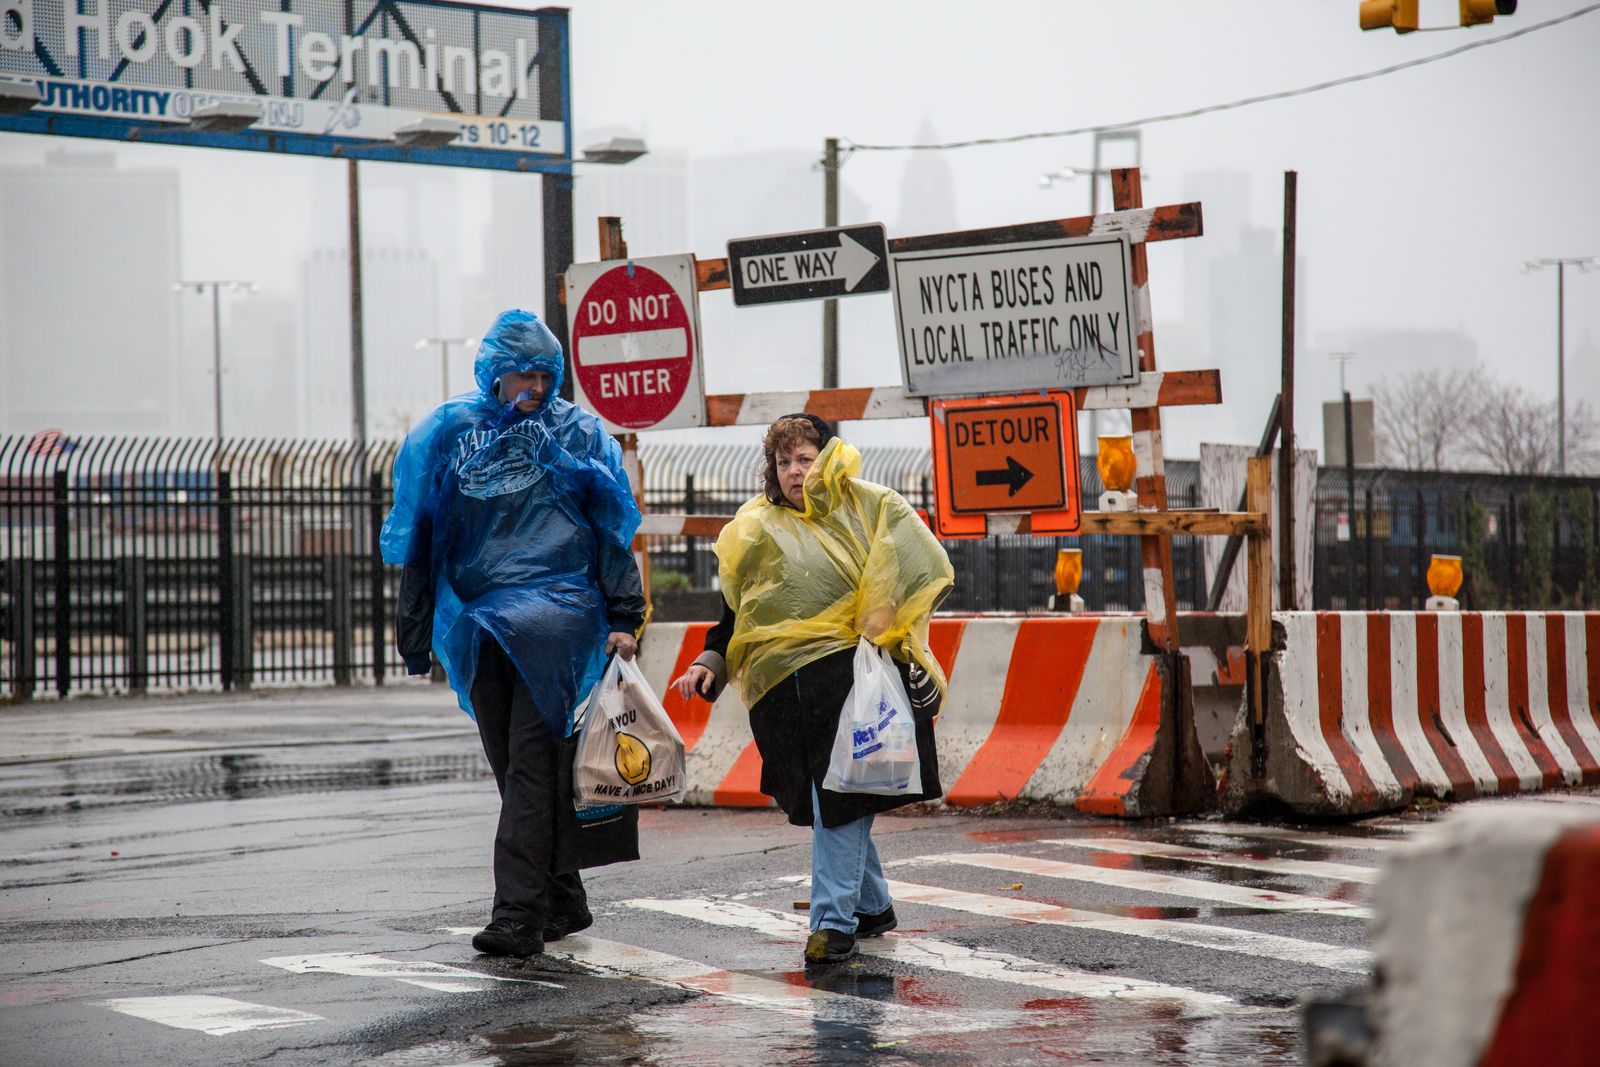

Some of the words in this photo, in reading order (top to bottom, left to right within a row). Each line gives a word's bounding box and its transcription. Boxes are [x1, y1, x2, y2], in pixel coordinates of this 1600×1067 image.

[66, 0, 246, 73] Hook
[261, 11, 529, 99] Terminal
[487, 121, 540, 147] 10-12
[746, 257, 789, 285] ONE
[795, 251, 838, 279] WAY
[919, 272, 984, 315] NYCTA
[991, 265, 1055, 309] BUSES
[1065, 261, 1103, 303] AND
[588, 299, 617, 326] DO
[629, 294, 670, 322] NOT
[911, 324, 974, 365] LOCAL
[980, 316, 1061, 361] TRAFFIC
[1070, 312, 1120, 357] ONLY
[599, 368, 671, 398] ENTER
[955, 416, 1050, 447] DETOUR
[615, 708, 637, 728] YOU
[594, 784, 623, 797] HAVE
[622, 788, 630, 798] A
[654, 775, 676, 792] DAY!
